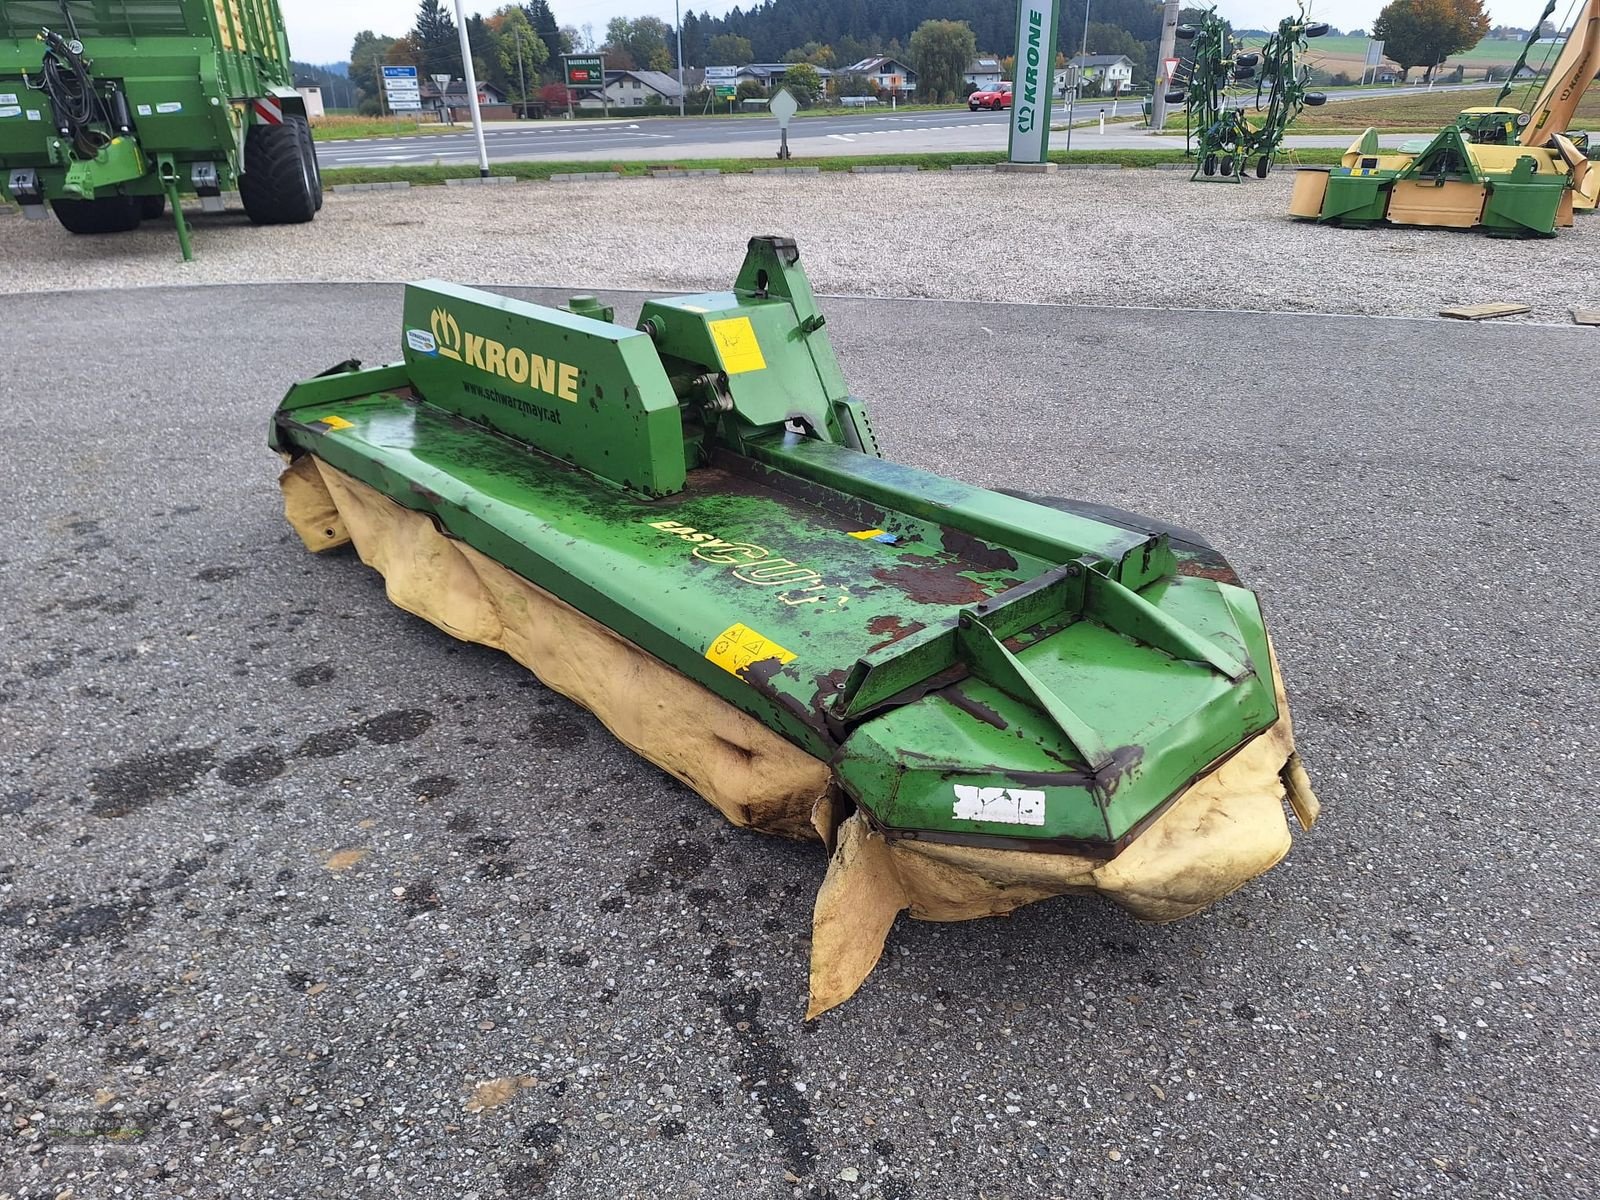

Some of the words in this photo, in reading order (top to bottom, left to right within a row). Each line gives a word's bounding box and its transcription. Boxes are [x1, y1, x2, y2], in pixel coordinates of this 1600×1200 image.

[1024, 9, 1042, 104] KRONE
[464, 331, 579, 404] KRONE
[462, 381, 561, 424] www.schwarzmayr.at
[648, 520, 734, 547] EASY
